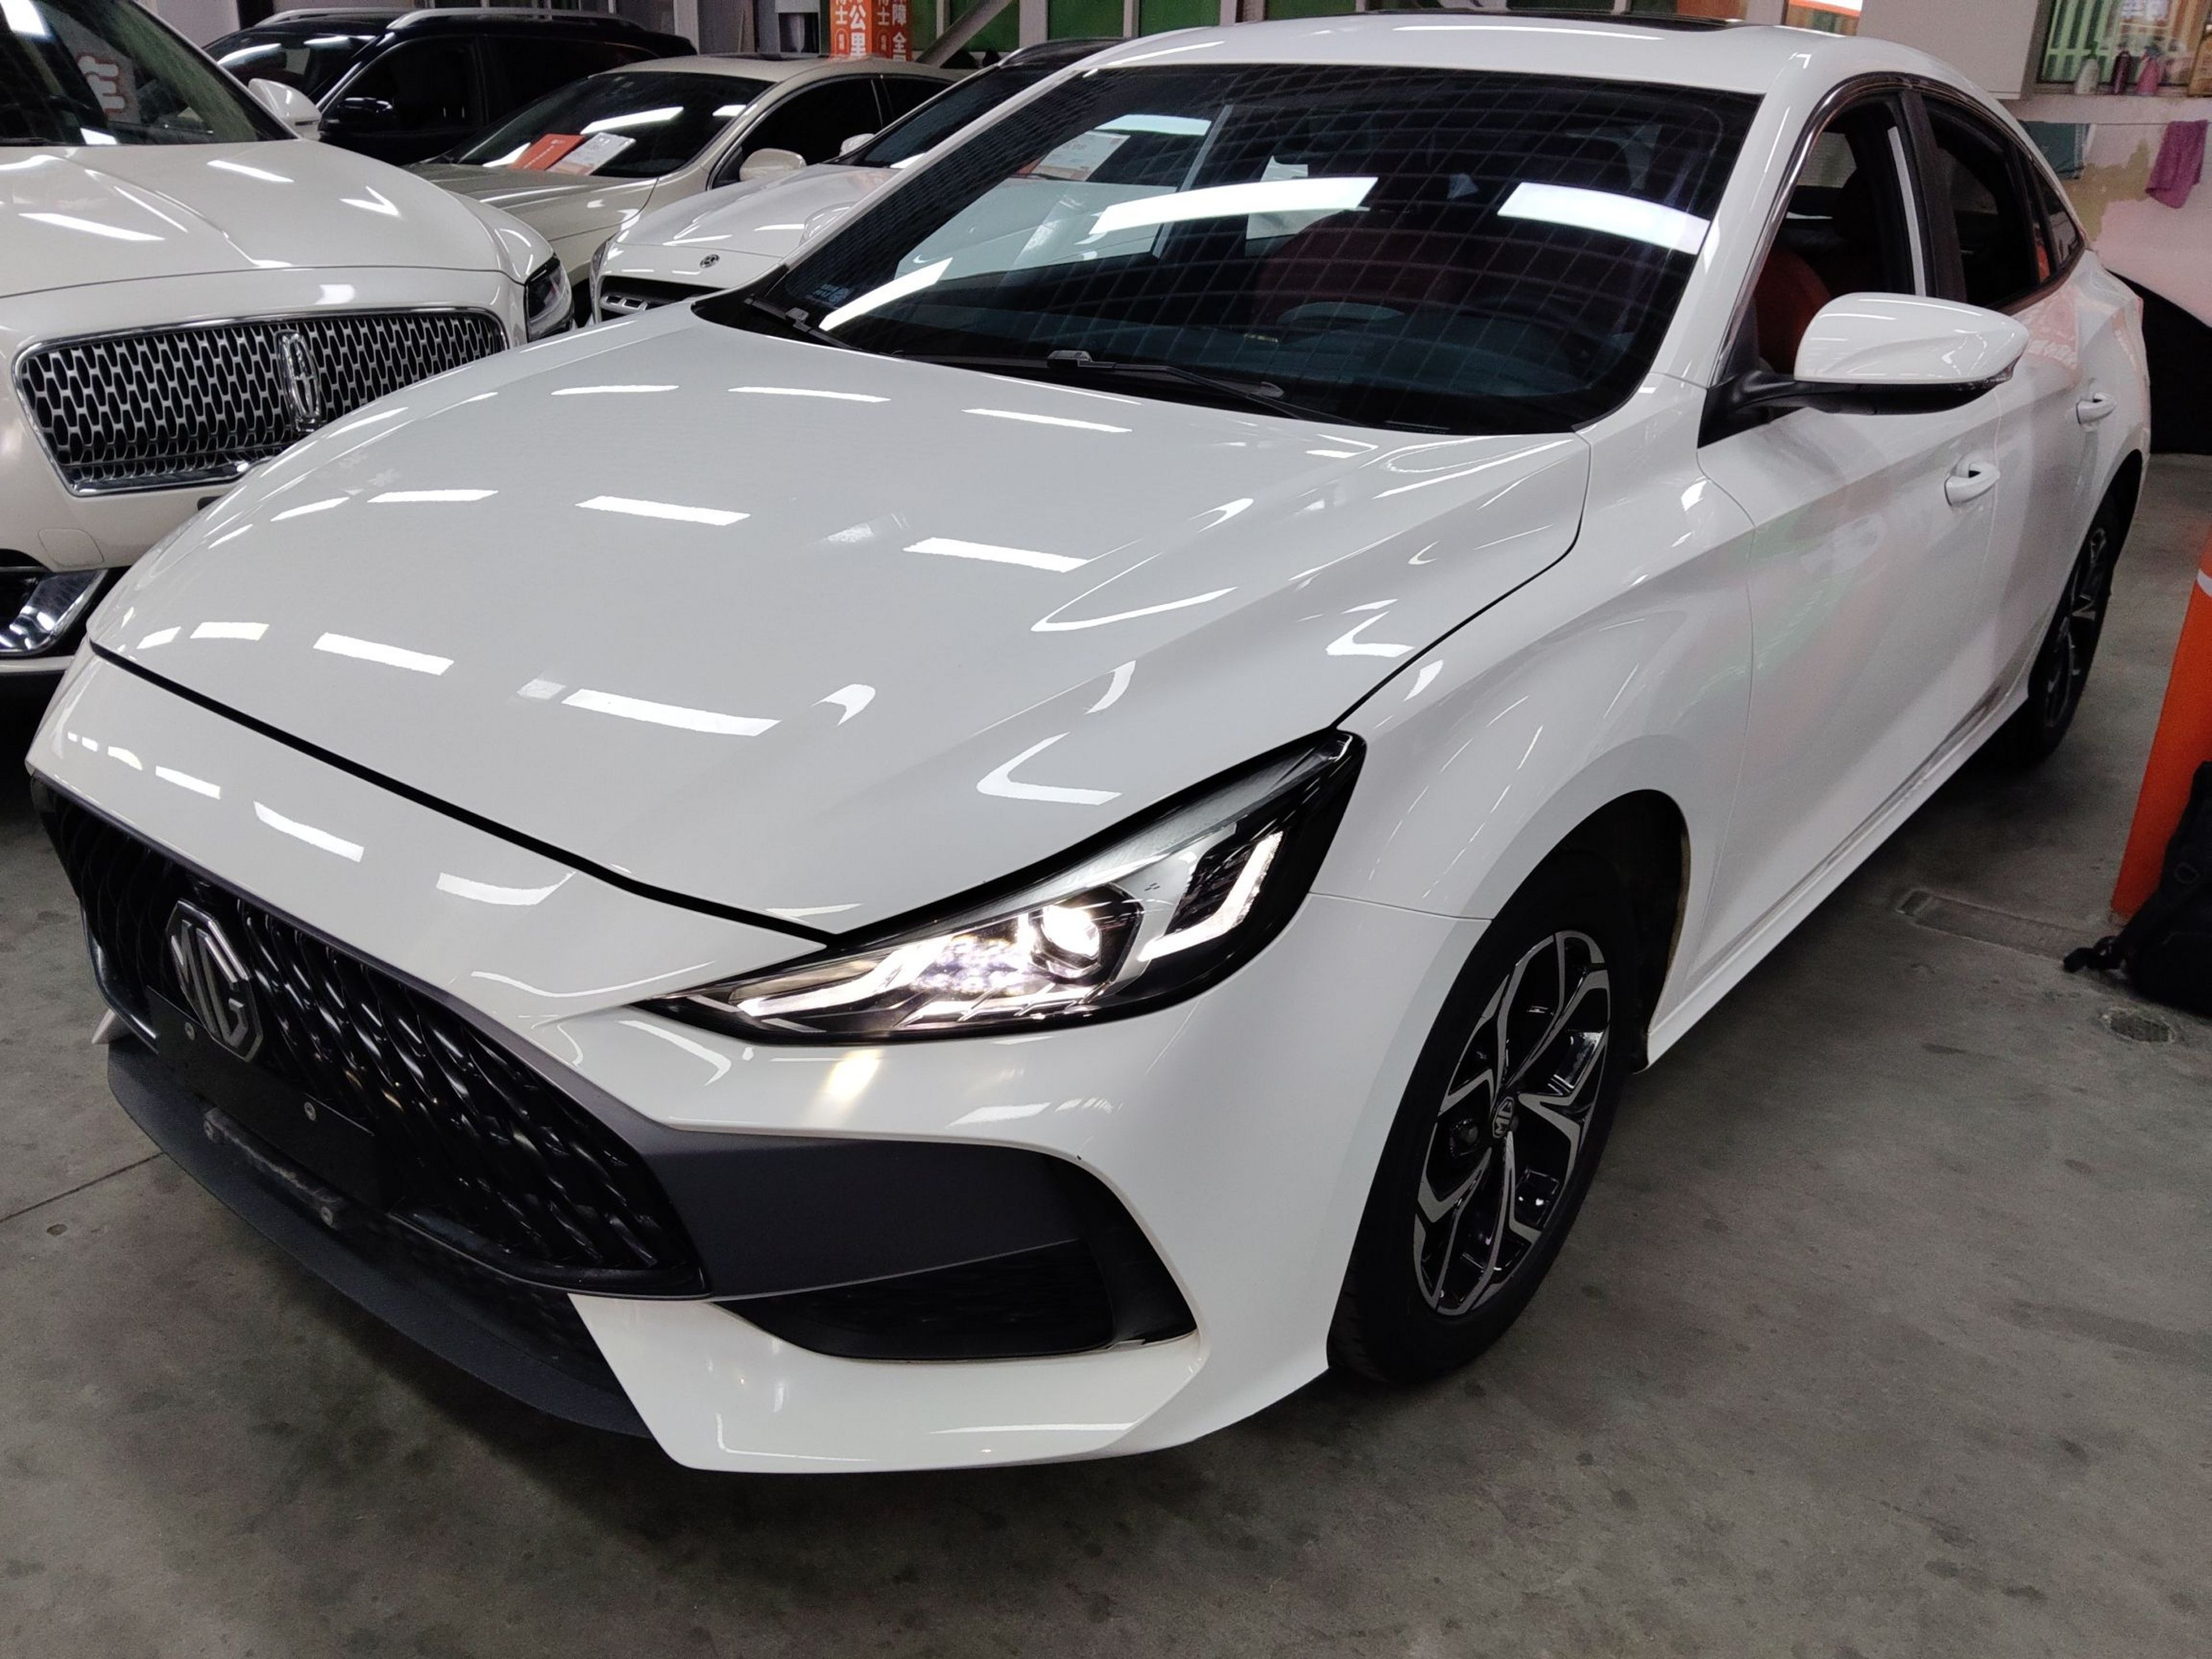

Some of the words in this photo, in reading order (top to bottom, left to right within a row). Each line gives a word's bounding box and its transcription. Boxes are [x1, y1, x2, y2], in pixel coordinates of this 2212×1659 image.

[835, 0, 848, 24] 士
[850, 0, 866, 56] 公里
[877, 0, 890, 25] 士
[171, 919, 249, 1048] MG
[1495, 1101, 1513, 1135] MG
